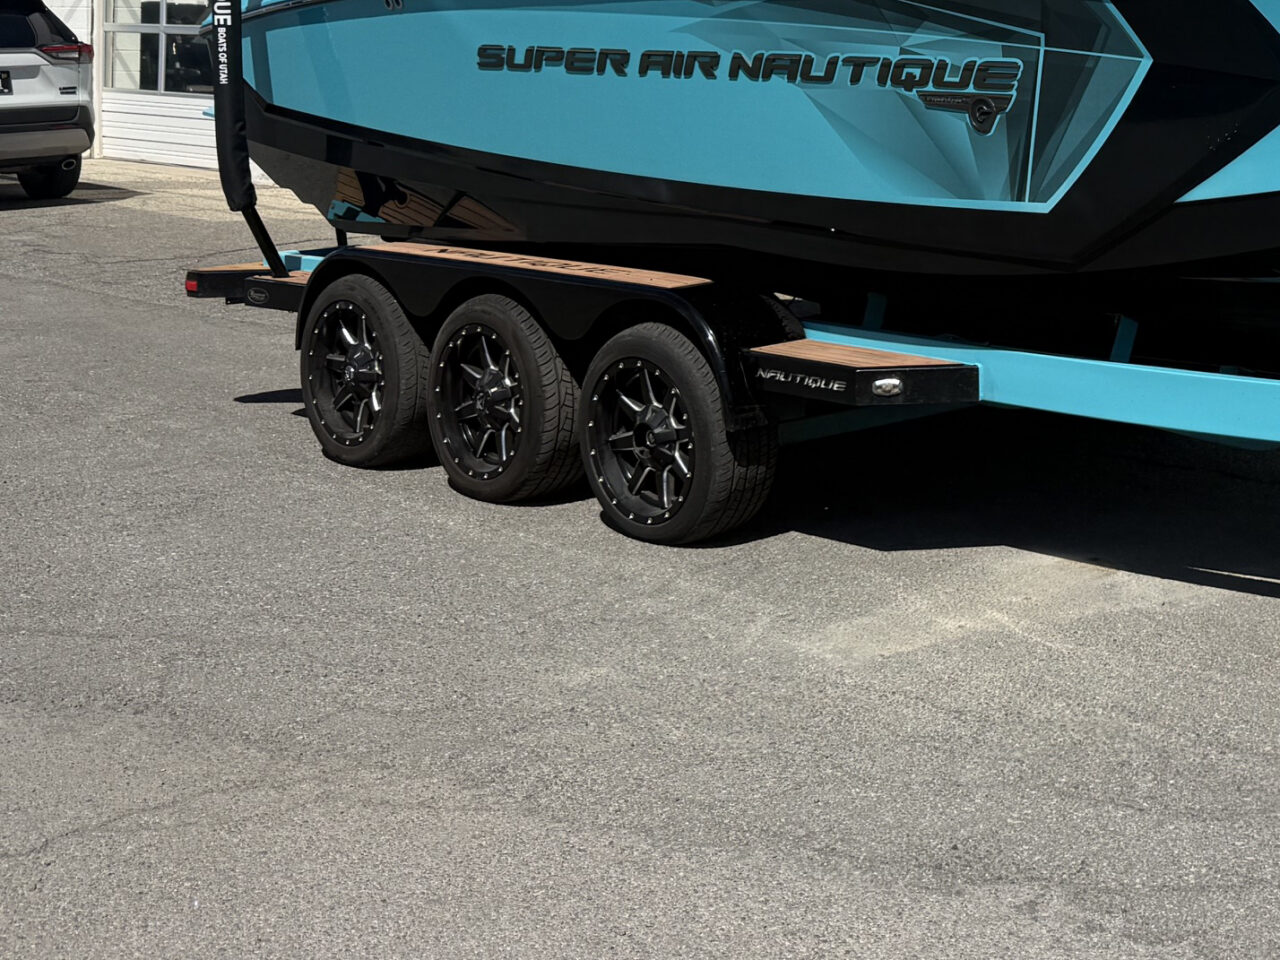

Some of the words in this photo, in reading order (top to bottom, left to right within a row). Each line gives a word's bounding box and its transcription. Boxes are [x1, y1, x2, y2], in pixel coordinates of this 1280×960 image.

[217, 27, 227, 53] BOATS
[218, 54, 228, 64] OF
[477, 44, 630, 77] SUPER
[638, 50, 720, 80] AIR
[729, 52, 1023, 91] NAUTIQUE
[219, 64, 228, 85] UTAH
[755, 368, 848, 391] NAUTIQUE
